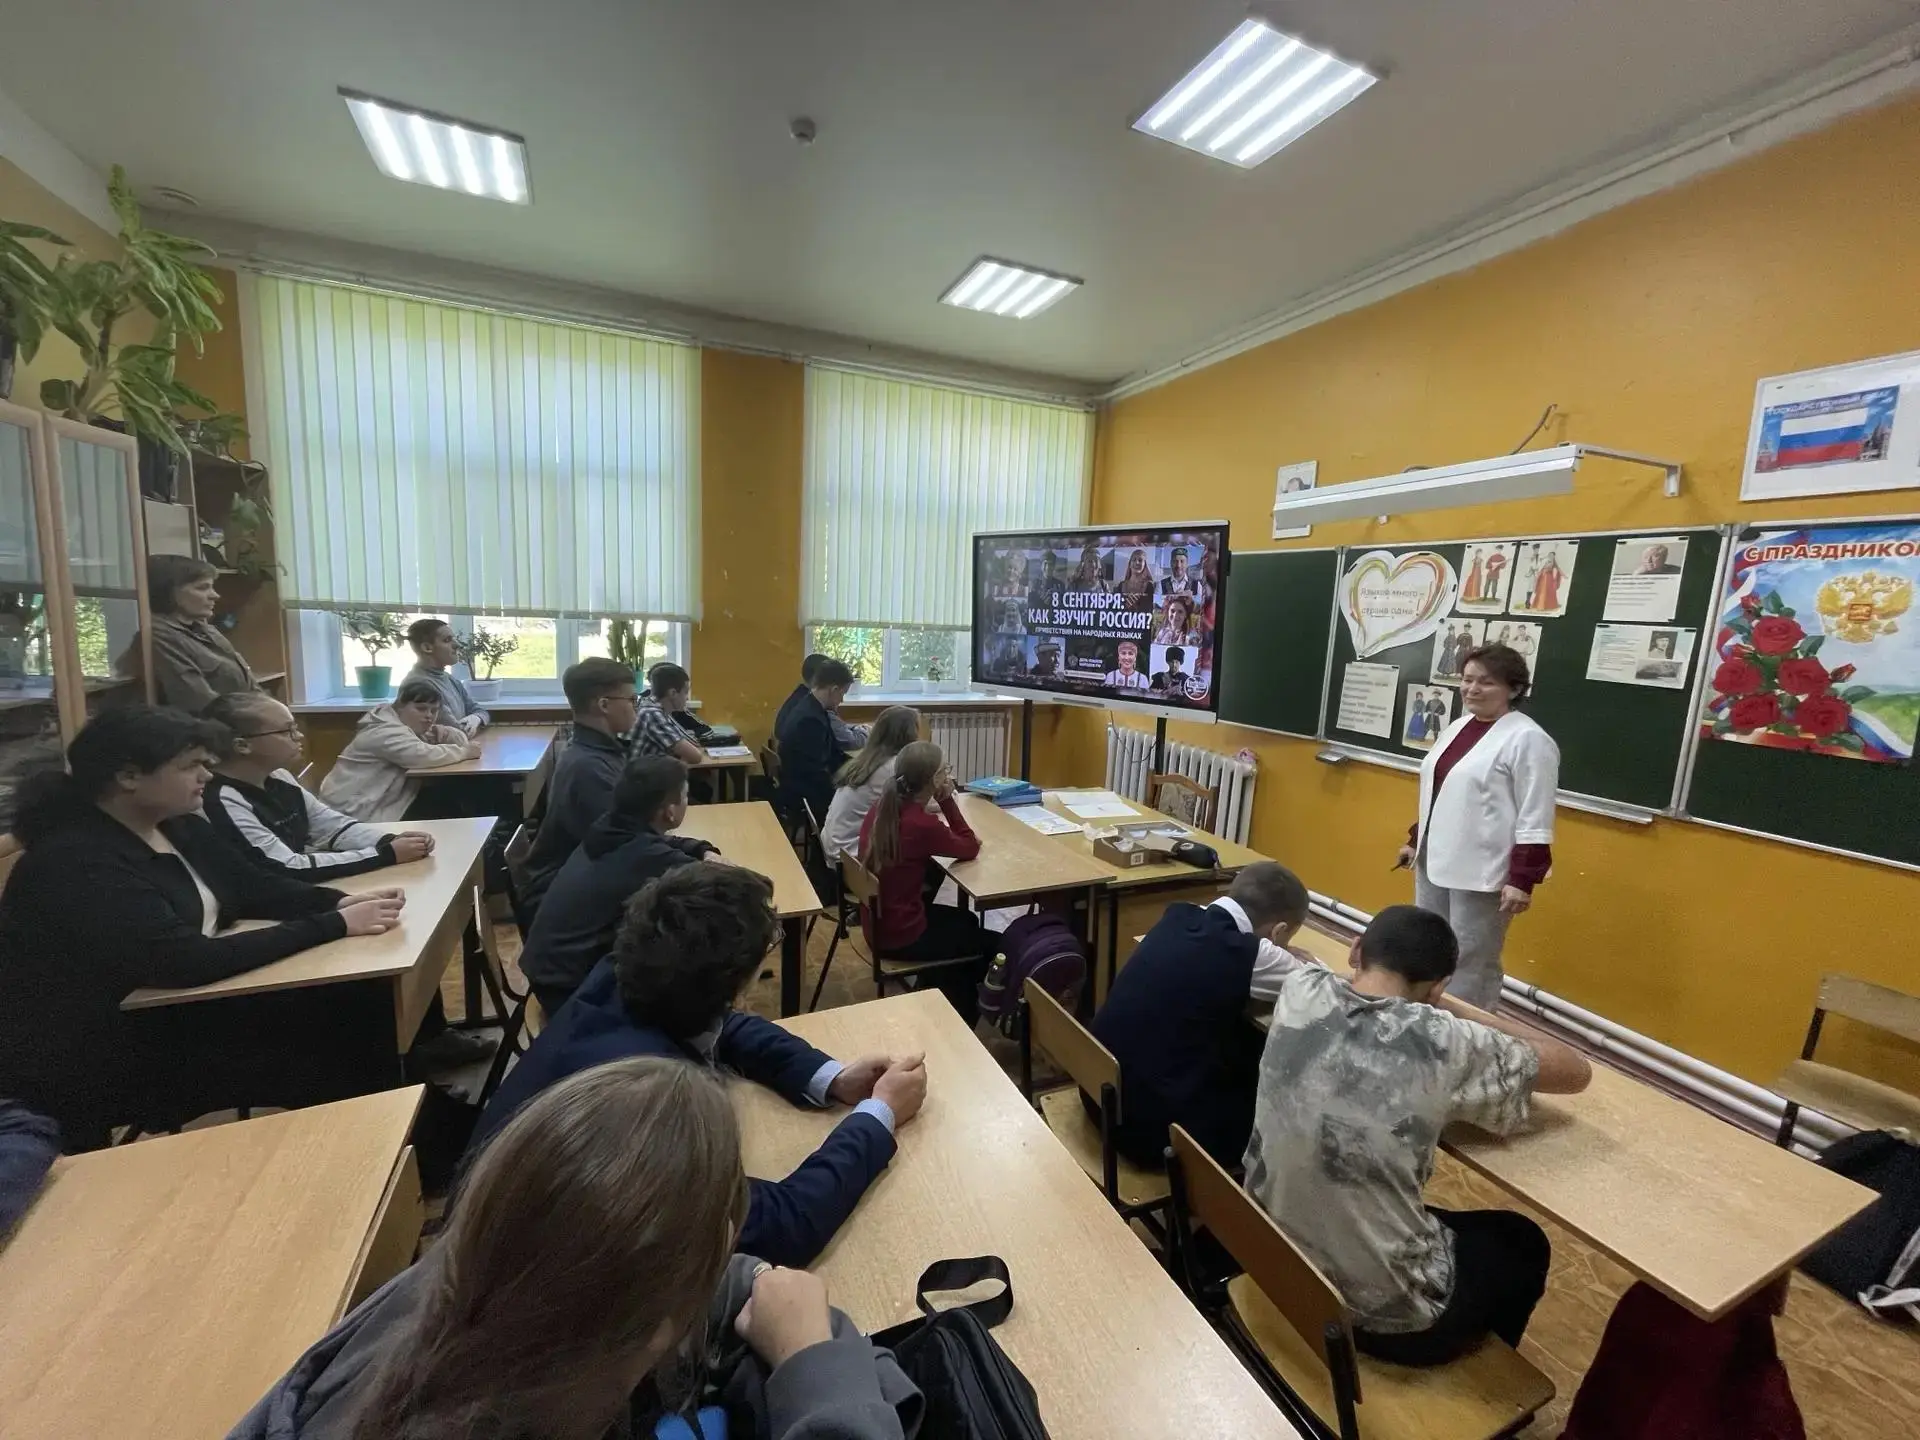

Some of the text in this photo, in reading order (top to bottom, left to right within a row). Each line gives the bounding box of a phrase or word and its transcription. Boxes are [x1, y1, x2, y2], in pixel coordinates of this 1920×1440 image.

[1744, 540, 1920, 561] С ПРАЗДНИКО
[1052, 592, 1125, 609] 8 СЕНТЯБРЯ:
[1028, 608, 1153, 630] КАК ЗВУЧИТ РОССИЯ?
[1082, 630, 1115, 638] НАРОДНЫХ
[1116, 631, 1142, 640] ЯЗЫКАХ
